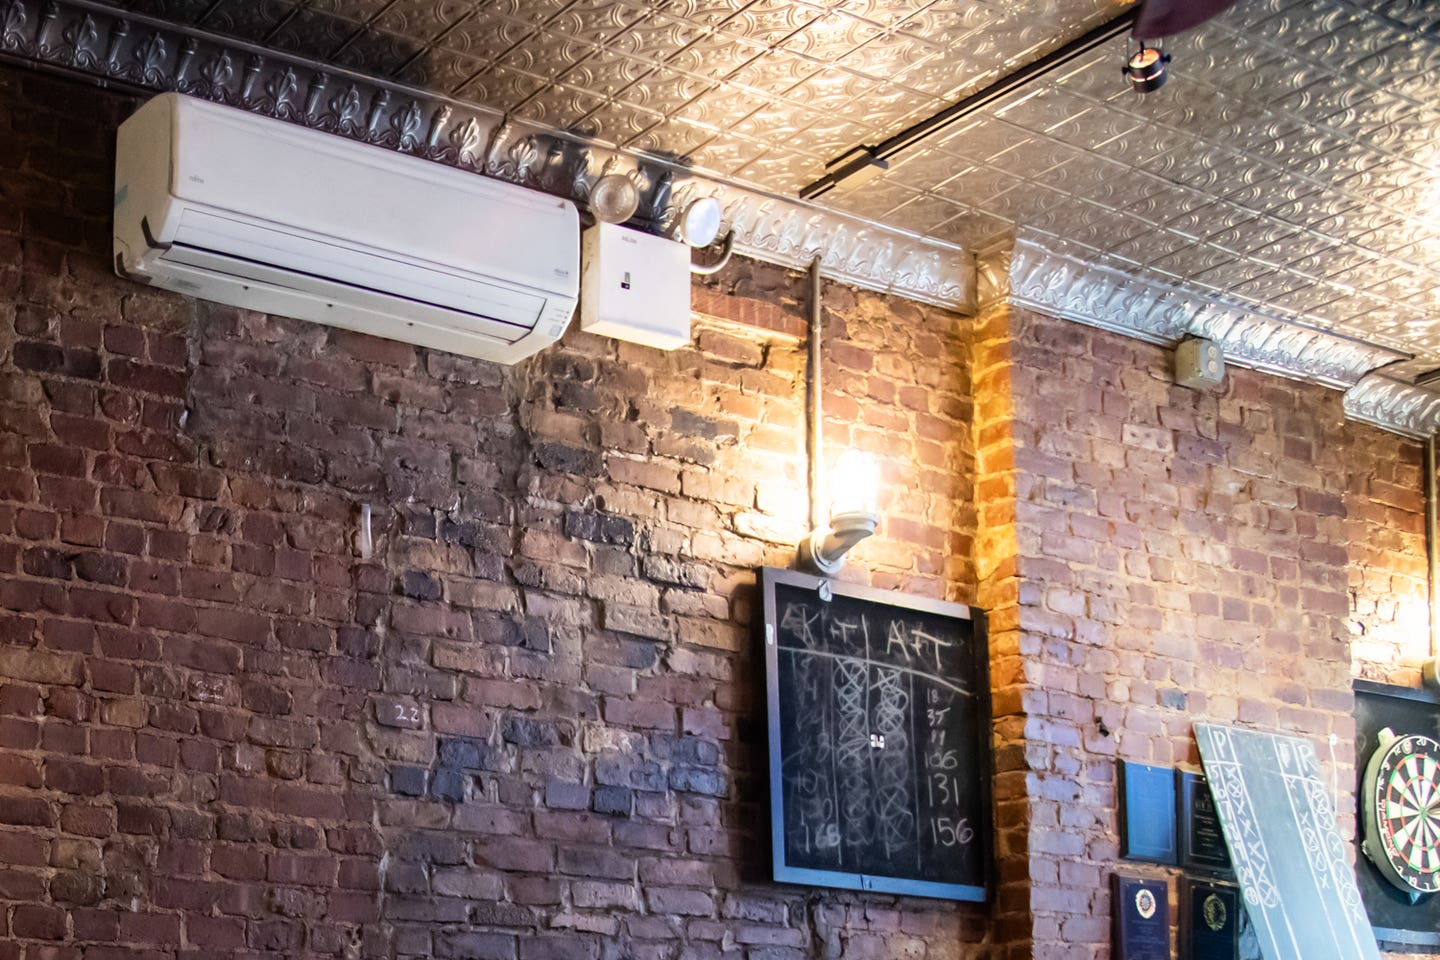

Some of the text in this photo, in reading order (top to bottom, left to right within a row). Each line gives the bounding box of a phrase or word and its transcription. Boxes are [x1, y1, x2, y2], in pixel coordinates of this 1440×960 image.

[1213, 730, 1227, 759] P
[1298, 744, 1319, 772] R
[924, 750, 958, 770] 106
[927, 773, 959, 807] 131
[931, 817, 974, 847] 156
